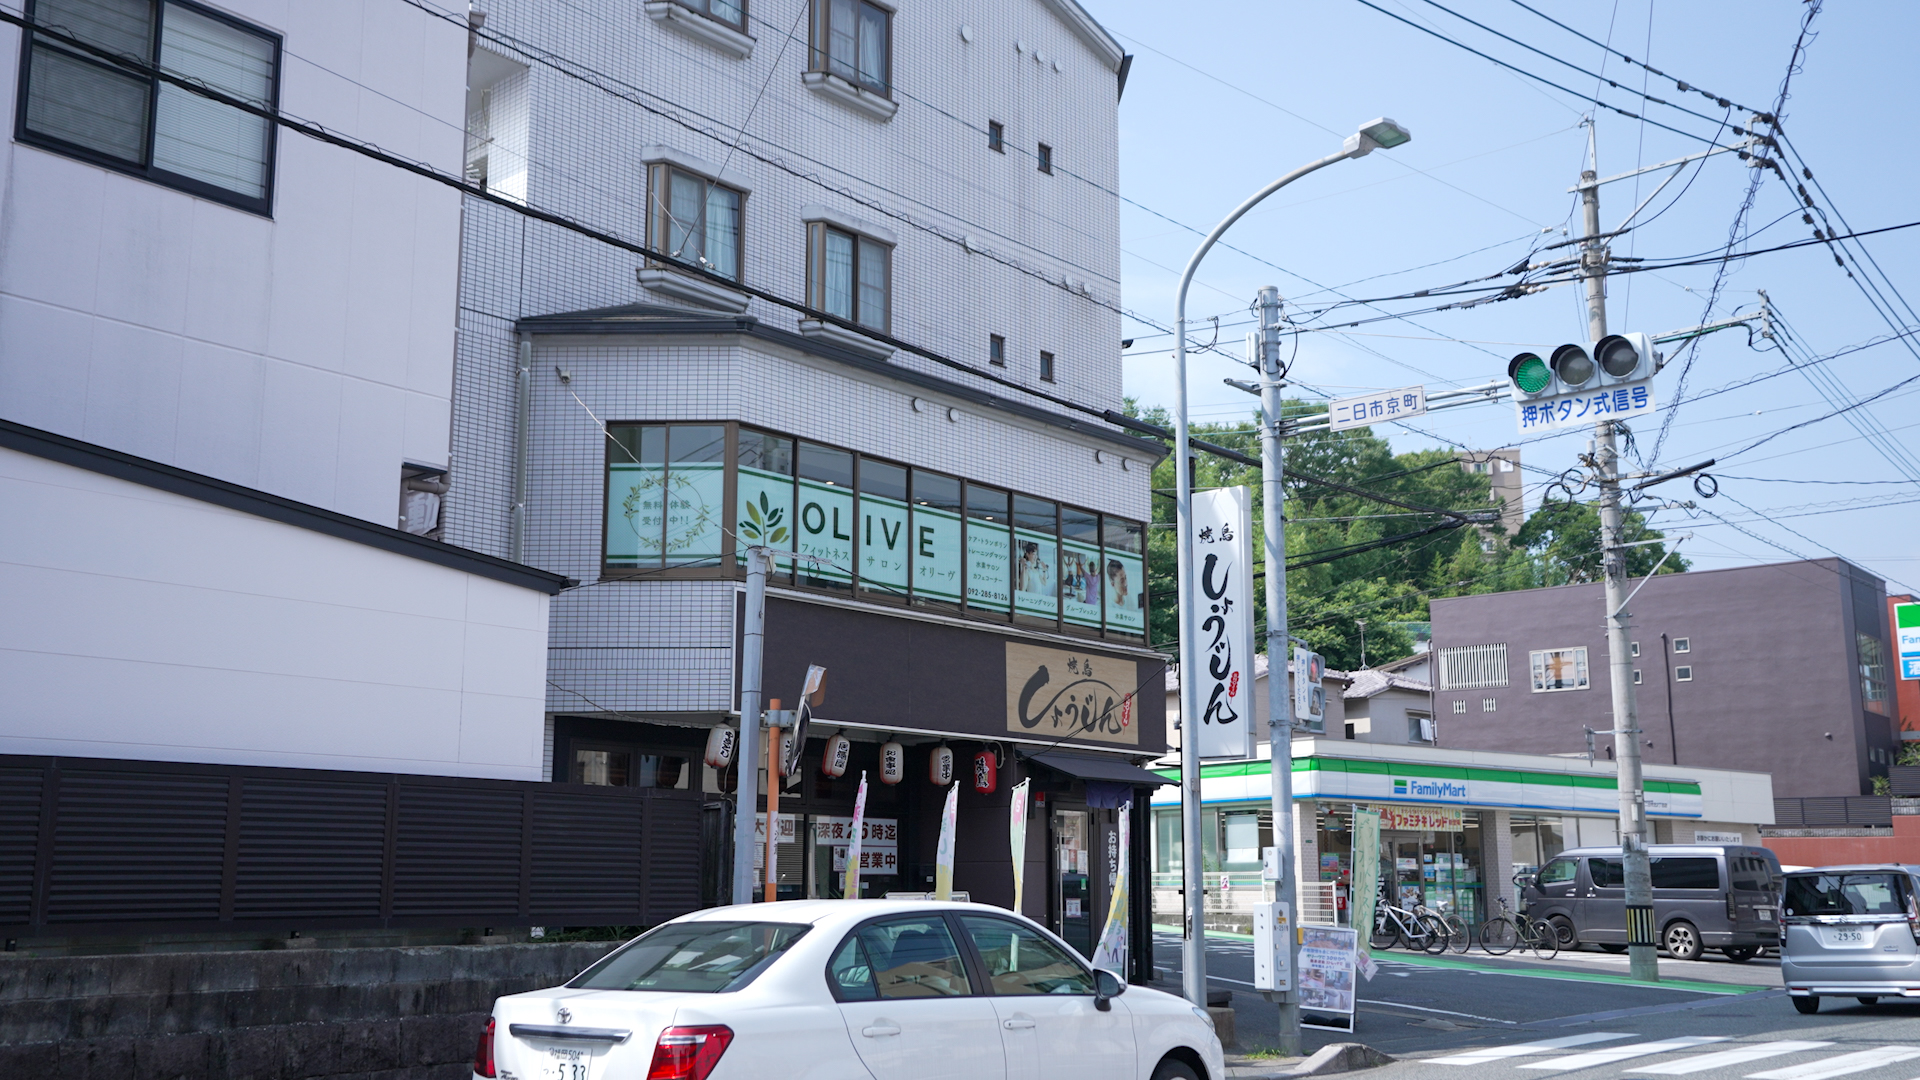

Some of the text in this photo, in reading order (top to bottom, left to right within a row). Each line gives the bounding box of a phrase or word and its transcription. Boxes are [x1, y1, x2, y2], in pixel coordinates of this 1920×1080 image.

[1337, 393, 1418, 424] 二日市京町
[1521, 386, 1650, 428] 押ボタン式信号
[802, 502, 935, 558] OLIVE
[1198, 522, 1234, 544] 焼鳥
[801, 543, 956, 581] フィットネス サロン オリーヴ
[967, 587, 1008, 601] 092-285-8126
[1201, 553, 1239, 725] しょうじん
[1067, 656, 1093, 677] 焼鳥
[1018, 664, 1124, 735] しょうじん
[1410, 780, 1466, 798] FamilyMart
[755, 819, 794, 836] 大迎
[1838, 932, 1862, 941] 29-50
[568, 1050, 581, 1061] 504
